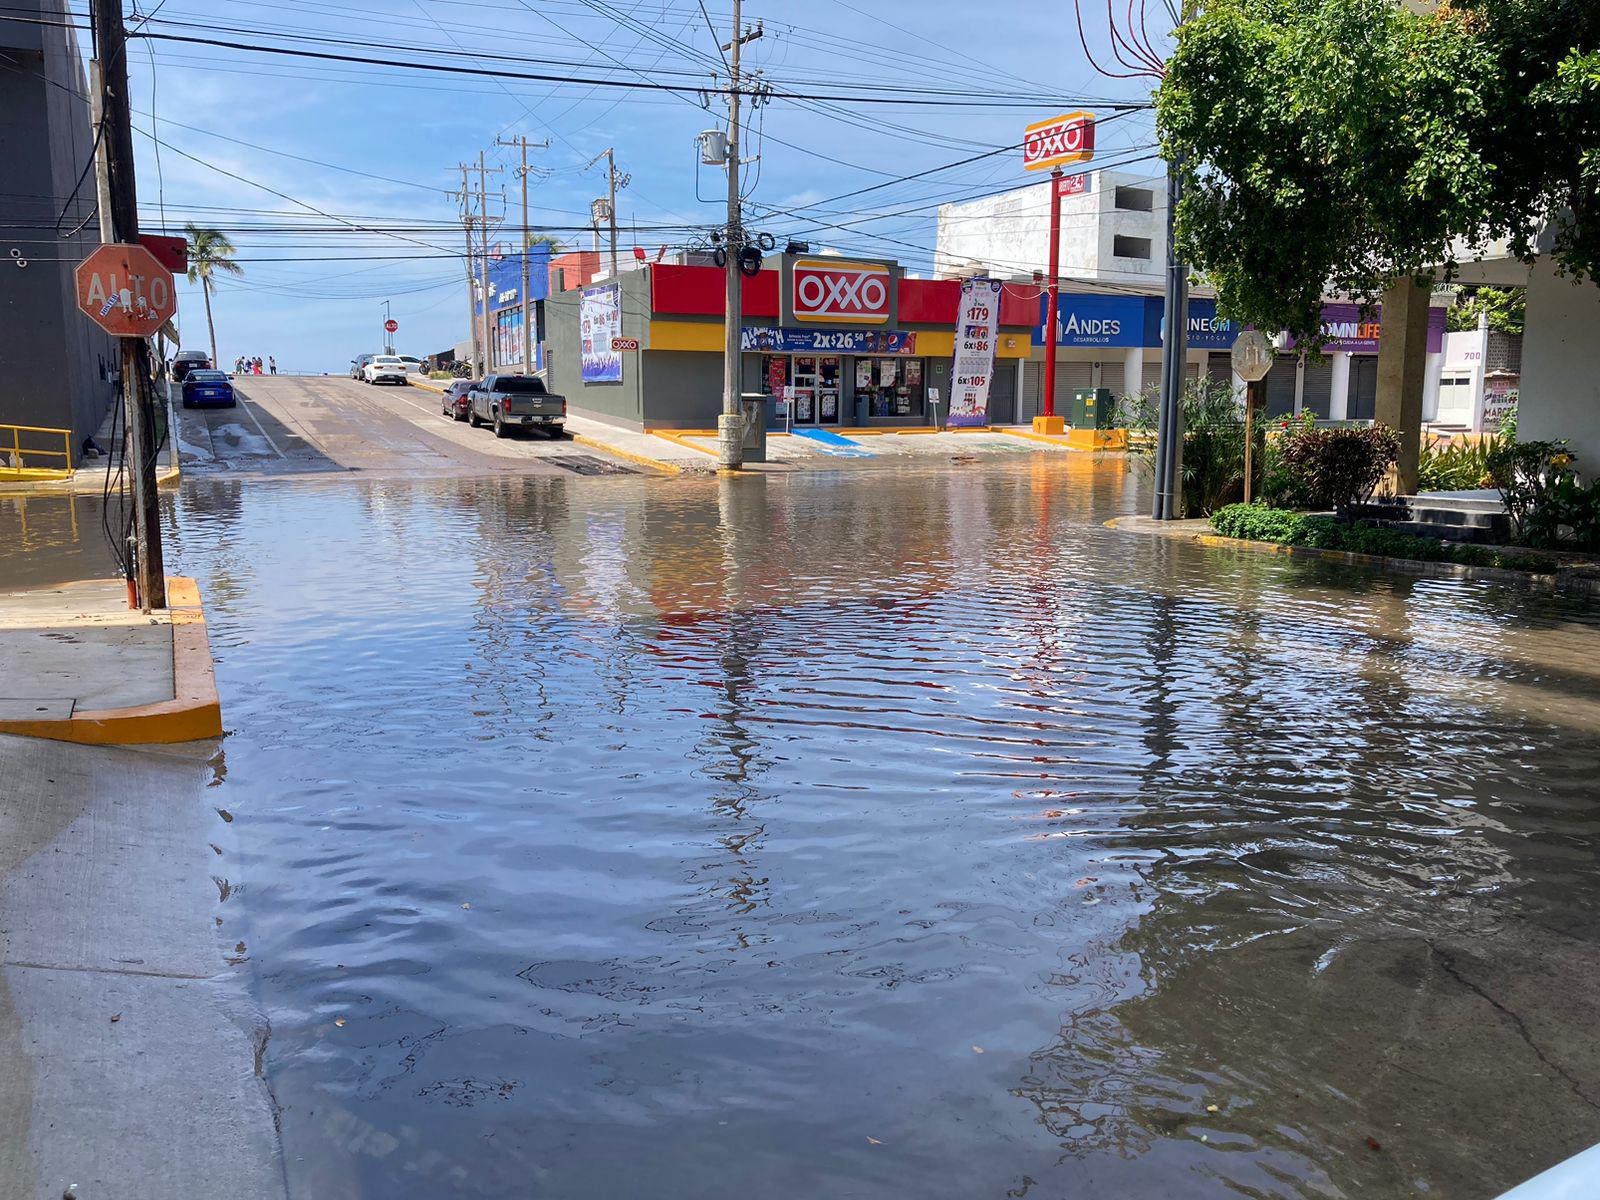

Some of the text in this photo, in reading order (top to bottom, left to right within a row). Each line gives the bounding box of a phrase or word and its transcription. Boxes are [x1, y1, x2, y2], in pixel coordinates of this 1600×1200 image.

[1026, 123, 1080, 160] OXXO
[86, 272, 168, 310] ALTO
[799, 273, 886, 311] OXXO
[967, 307, 989, 321] $179
[1064, 312, 1121, 335] ANDES
[1320, 322, 1380, 339] OMNILIFE
[612, 341, 637, 349] OXXO
[1464, 352, 1481, 360] 700
